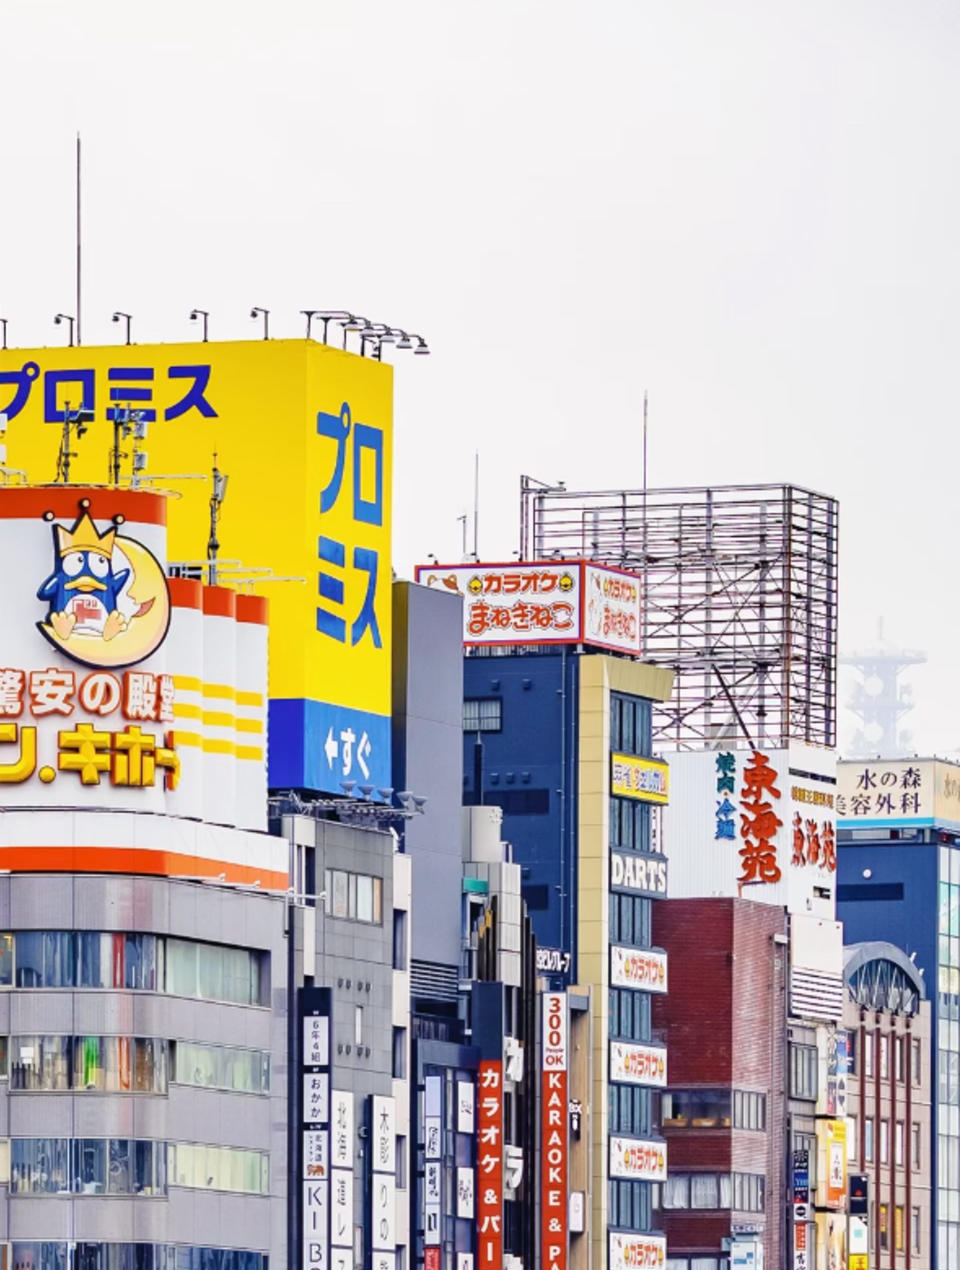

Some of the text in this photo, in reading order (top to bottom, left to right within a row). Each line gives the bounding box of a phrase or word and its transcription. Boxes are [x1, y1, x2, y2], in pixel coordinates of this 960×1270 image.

[315, 402, 384, 650] プロミス
[483, 574, 559, 593] カラオケ
[468, 602, 574, 634] まねきねこ
[340, 726, 372, 779] すぐ
[857, 767, 921, 790] 水の森
[739, 751, 782, 884] 東海苑
[612, 854, 666, 893] DARTS
[548, 997, 561, 1046] 300
[545, 1055, 563, 1066] OK
[548, 1073, 562, 1207] KARAOKE
